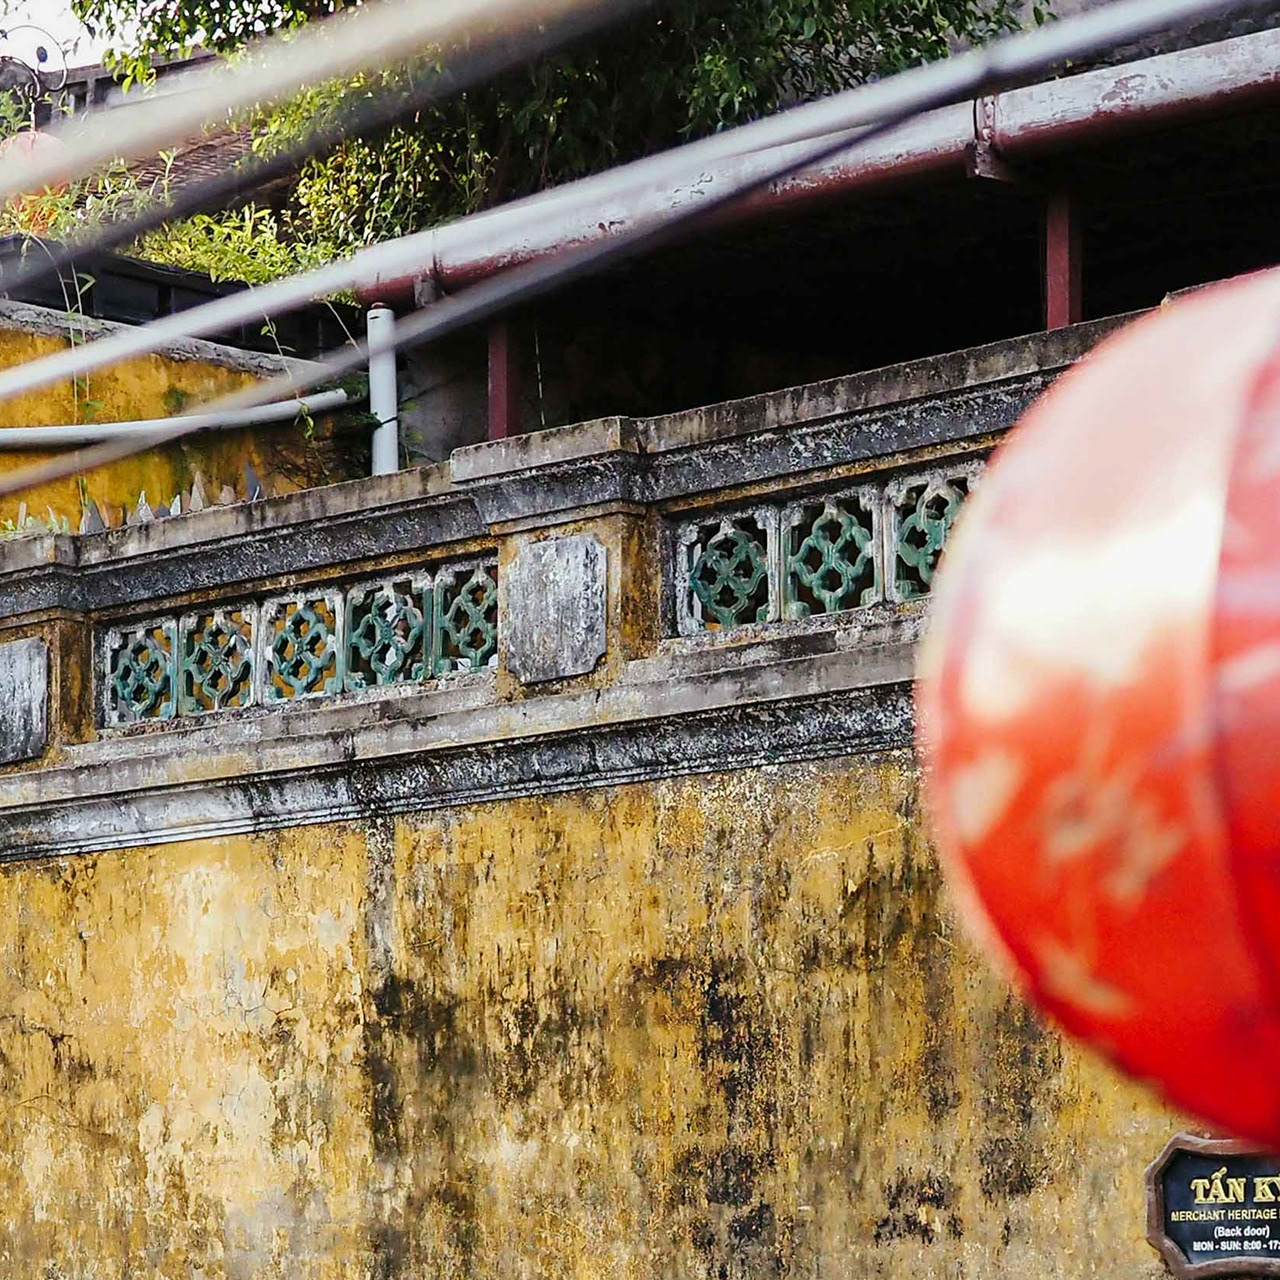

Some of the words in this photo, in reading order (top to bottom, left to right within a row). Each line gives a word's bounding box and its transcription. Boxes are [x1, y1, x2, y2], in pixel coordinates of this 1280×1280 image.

[1190, 1166, 1247, 1204] TẤN
[1171, 1209, 1226, 1222] MERCHANT
[1227, 1208, 1278, 1221] HERITAGE
[1214, 1225, 1242, 1239] (Back
[1243, 1225, 1271, 1238] door)
[1192, 1241, 1214, 1251] MON
